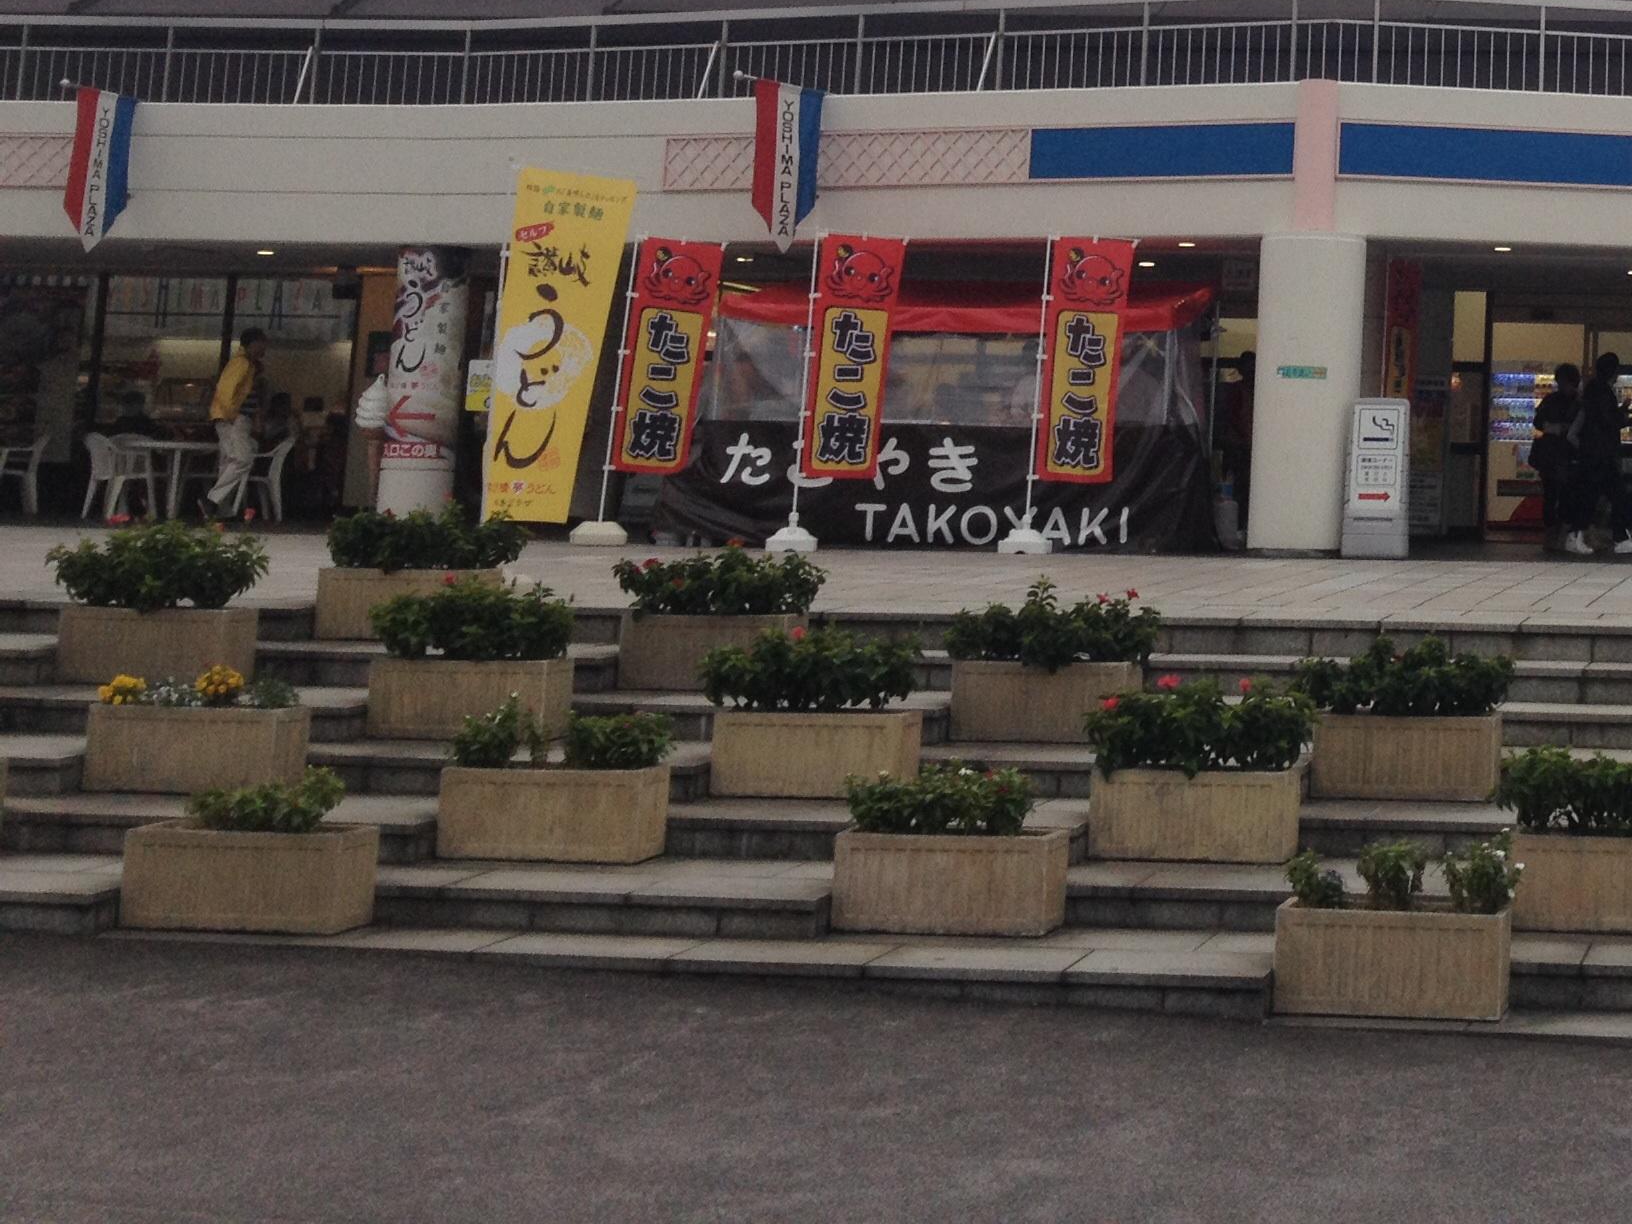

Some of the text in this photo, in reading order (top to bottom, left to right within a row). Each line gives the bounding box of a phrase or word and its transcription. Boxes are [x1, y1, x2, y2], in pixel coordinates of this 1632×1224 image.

[84, 109, 110, 236] YOSHIMA PLAZA
[778, 100, 794, 236] YOSHIMA PLAZA
[396, 279, 426, 373] うどん
[493, 283, 565, 469] うどん
[627, 311, 690, 461] たこ焼
[817, 311, 877, 464] たこ焼
[1053, 314, 1107, 470] たこ焼
[855, 503, 1130, 545] TAKOYAKI
